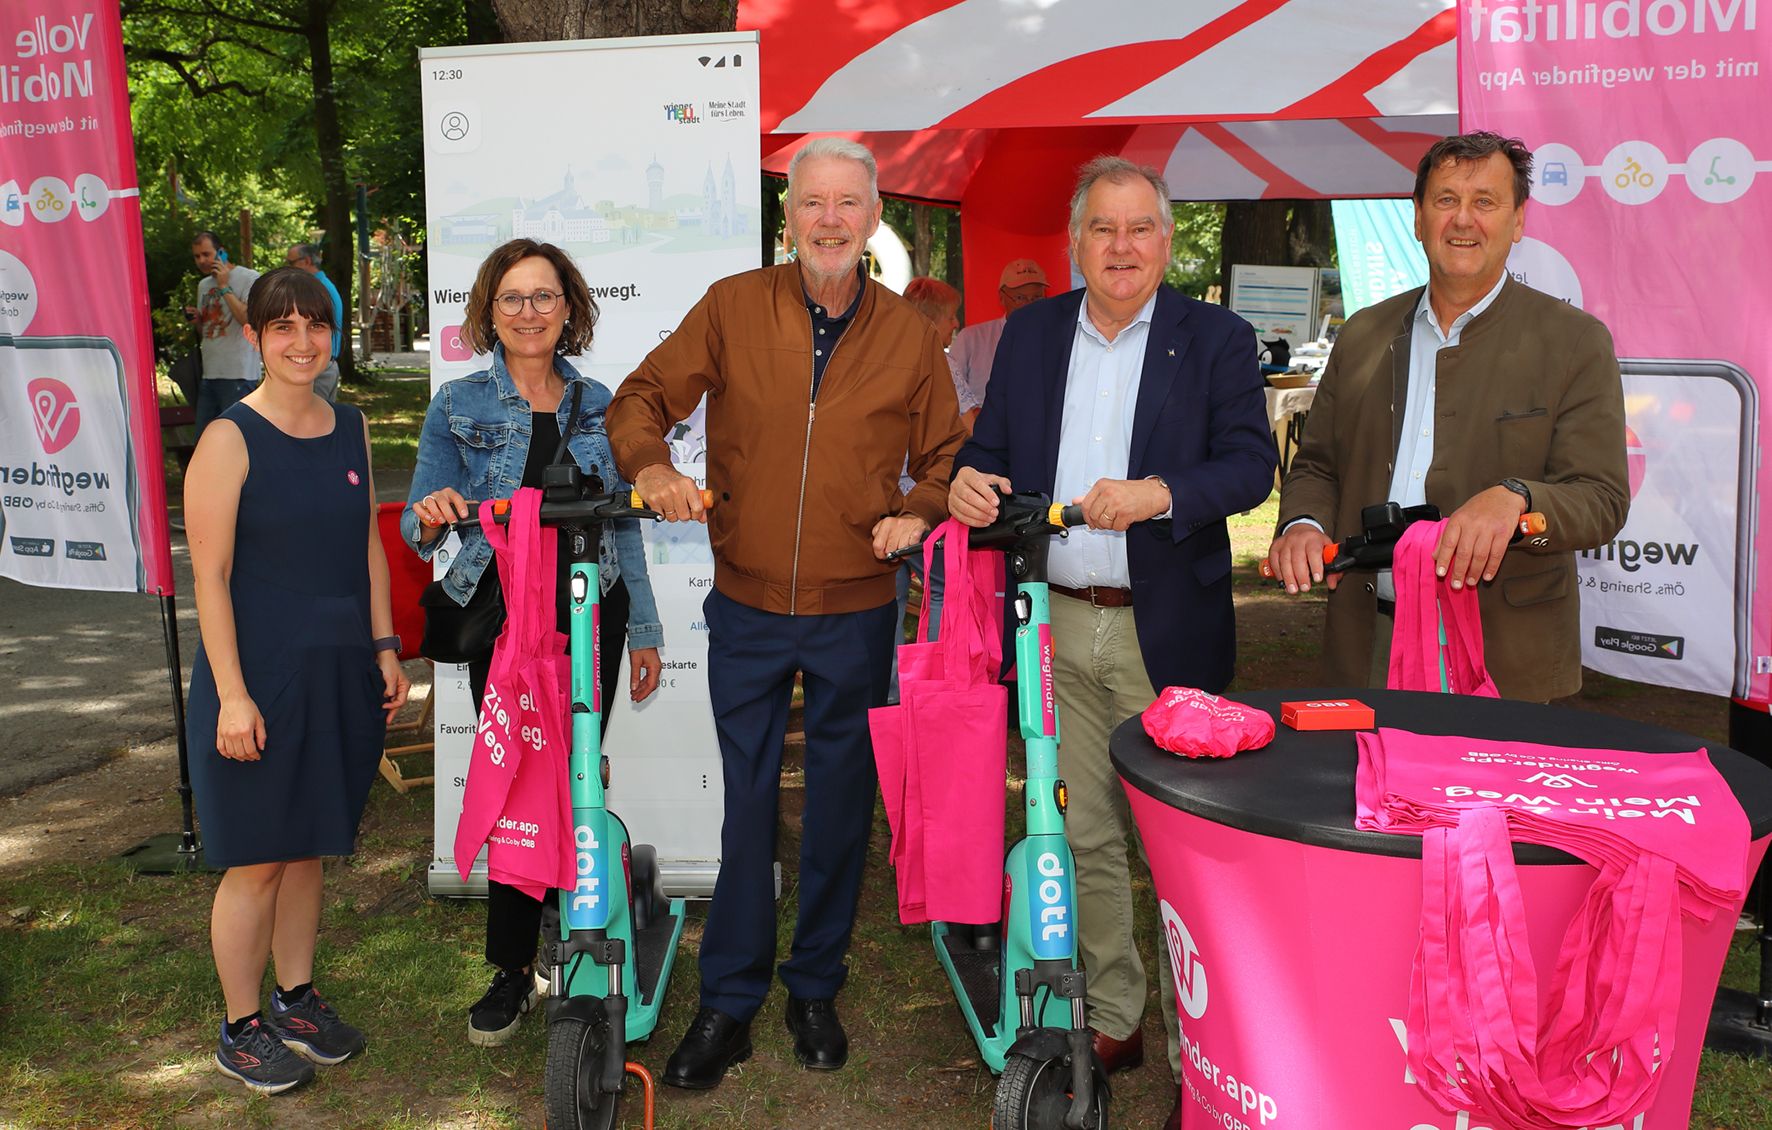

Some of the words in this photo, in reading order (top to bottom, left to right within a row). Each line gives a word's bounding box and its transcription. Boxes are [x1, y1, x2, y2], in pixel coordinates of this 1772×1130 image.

[432, 69, 463, 81] 12:30
[663, 103, 692, 111] wiener
[709, 101, 726, 109] Meine
[679, 116, 700, 124] stadt
[434, 289, 470, 304] Wien
[588, 284, 641, 301] ewegt.
[661, 661, 697, 670] eskarte
[670, 679, 677, 688] €
[1042, 644, 1054, 715] wegfinder
[440, 723, 477, 734] Favorit
[521, 725, 547, 751] eg.
[1460, 756, 1639, 774] wegfinder.app
[453, 777, 466, 787] St
[1433, 786, 1561, 806] Weg.
[1576, 795, 1701, 808] Mein
[1569, 807, 1696, 825] Mein
[573, 825, 600, 911] dott
[1037, 852, 1067, 941] dott
[1201, 1096, 1212, 1113] Co
[1212, 1105, 1223, 1125] by
